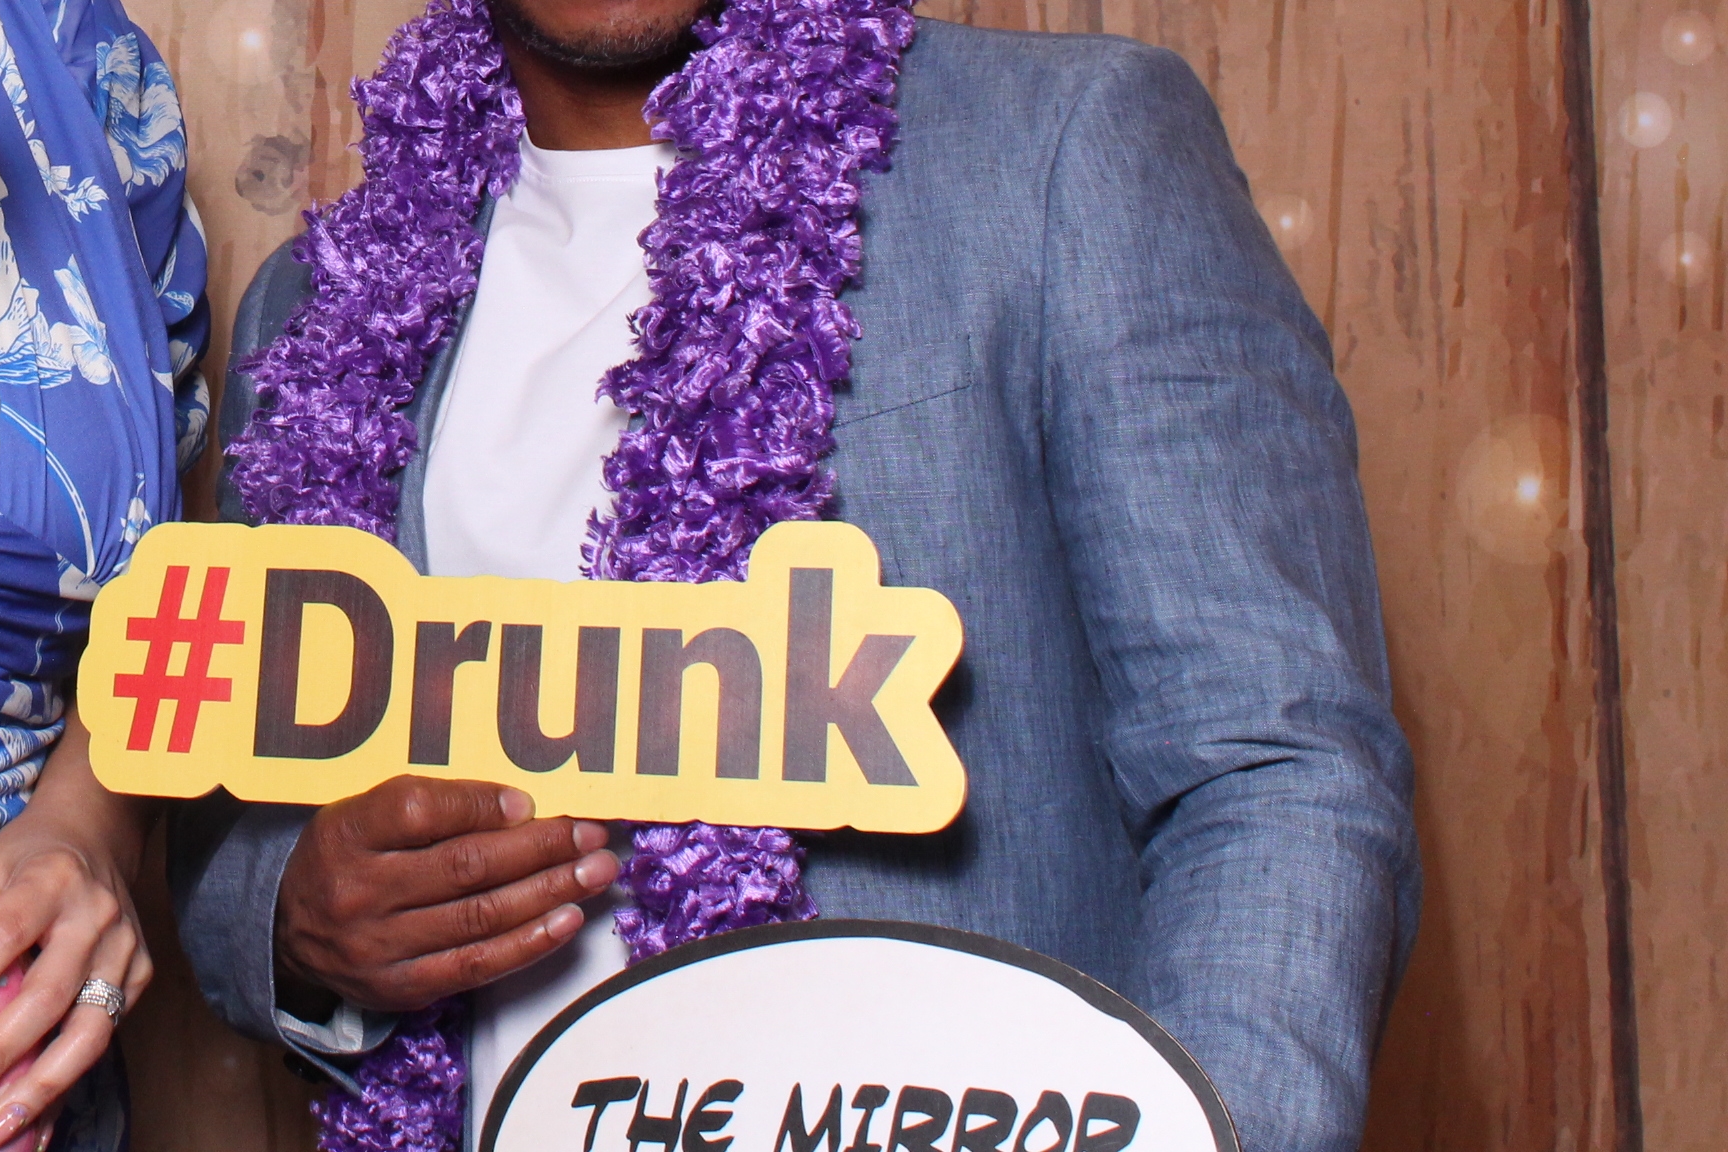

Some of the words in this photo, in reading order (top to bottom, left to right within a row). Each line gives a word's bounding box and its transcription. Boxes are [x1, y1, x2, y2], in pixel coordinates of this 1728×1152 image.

[113, 564, 919, 787] #Drunk
[571, 1076, 744, 1152] THE
[772, 1082, 1141, 1152] MIRROR
